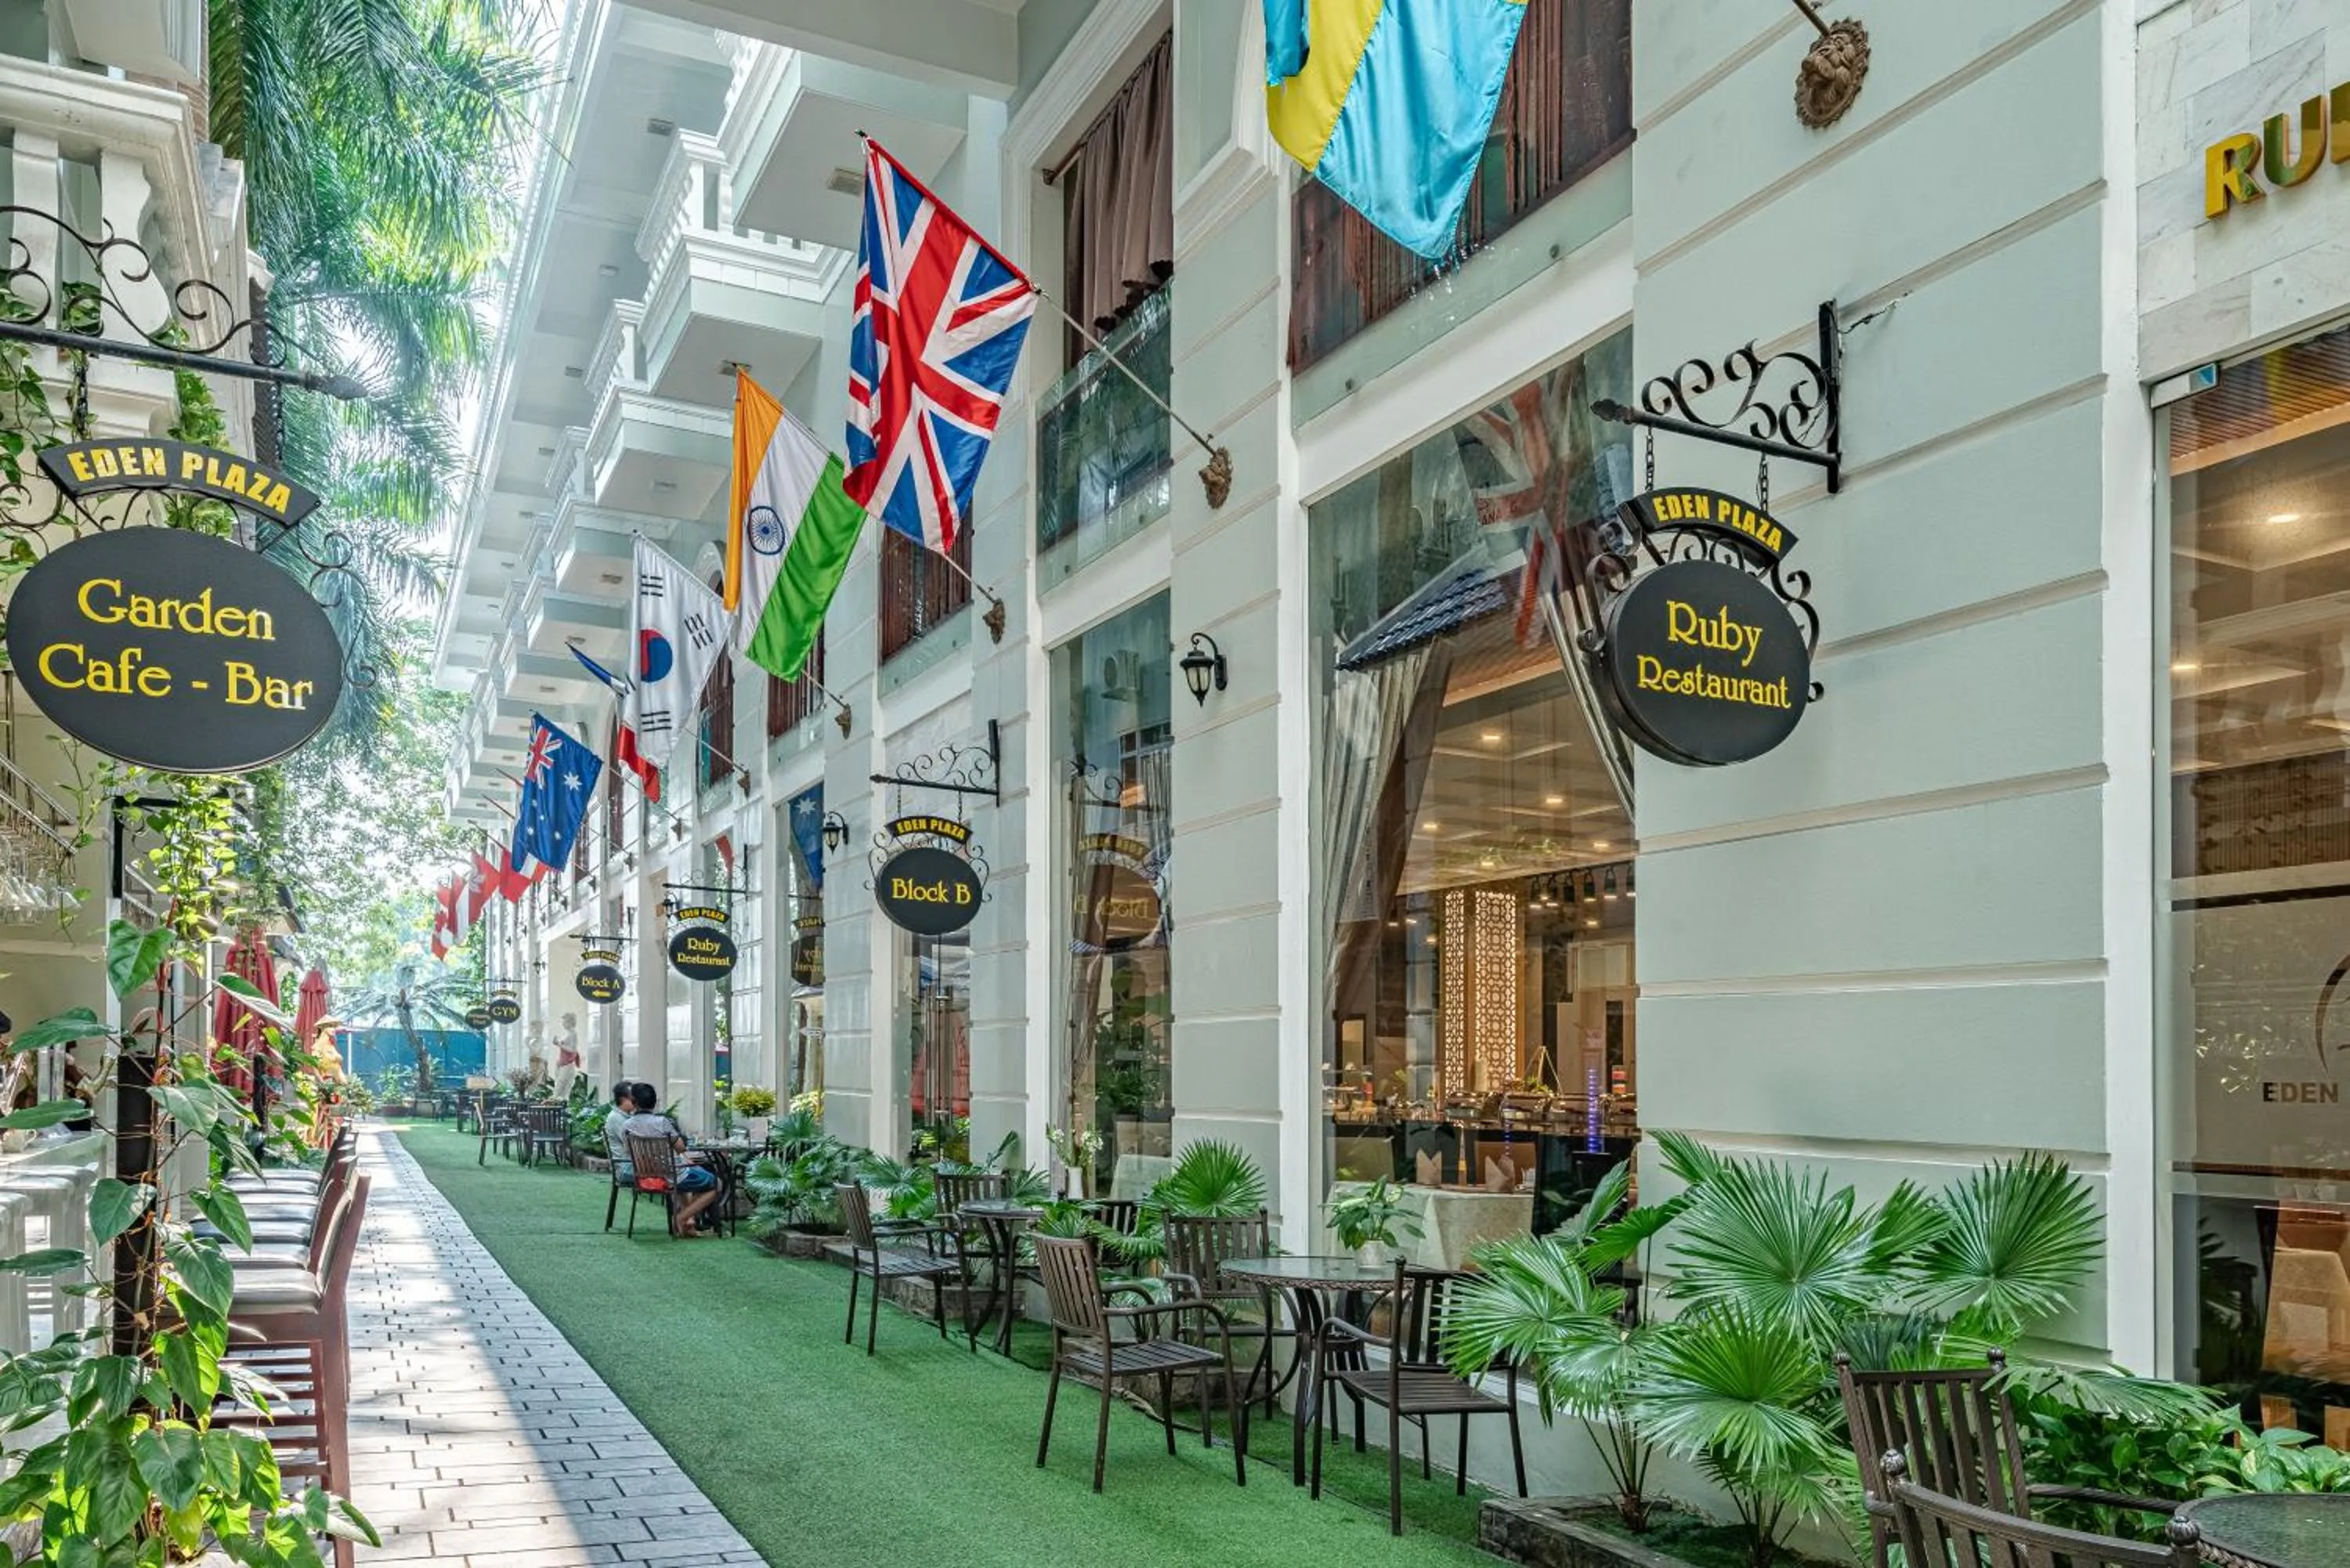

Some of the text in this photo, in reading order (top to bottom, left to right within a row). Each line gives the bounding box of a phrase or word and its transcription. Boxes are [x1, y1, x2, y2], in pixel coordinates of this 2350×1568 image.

[67, 446, 291, 515] EDEN PLAZA
[1654, 494, 1783, 553] EDEN PLAZA
[78, 578, 276, 641] Garden
[1667, 599, 1762, 668] Ruby
[38, 643, 172, 697] Cafe
[224, 661, 313, 710] Bar
[1637, 654, 1791, 709] Restaurant
[896, 818, 965, 840] EDEN PLAZA
[891, 878, 971, 904] Block B
[701, 908, 725, 922] PLAZA
[677, 952, 731, 966] Restaurant
[687, 938, 721, 956] Ruby
[582, 976, 620, 989] Block A
[2262, 1082, 2338, 1104] EDEN
